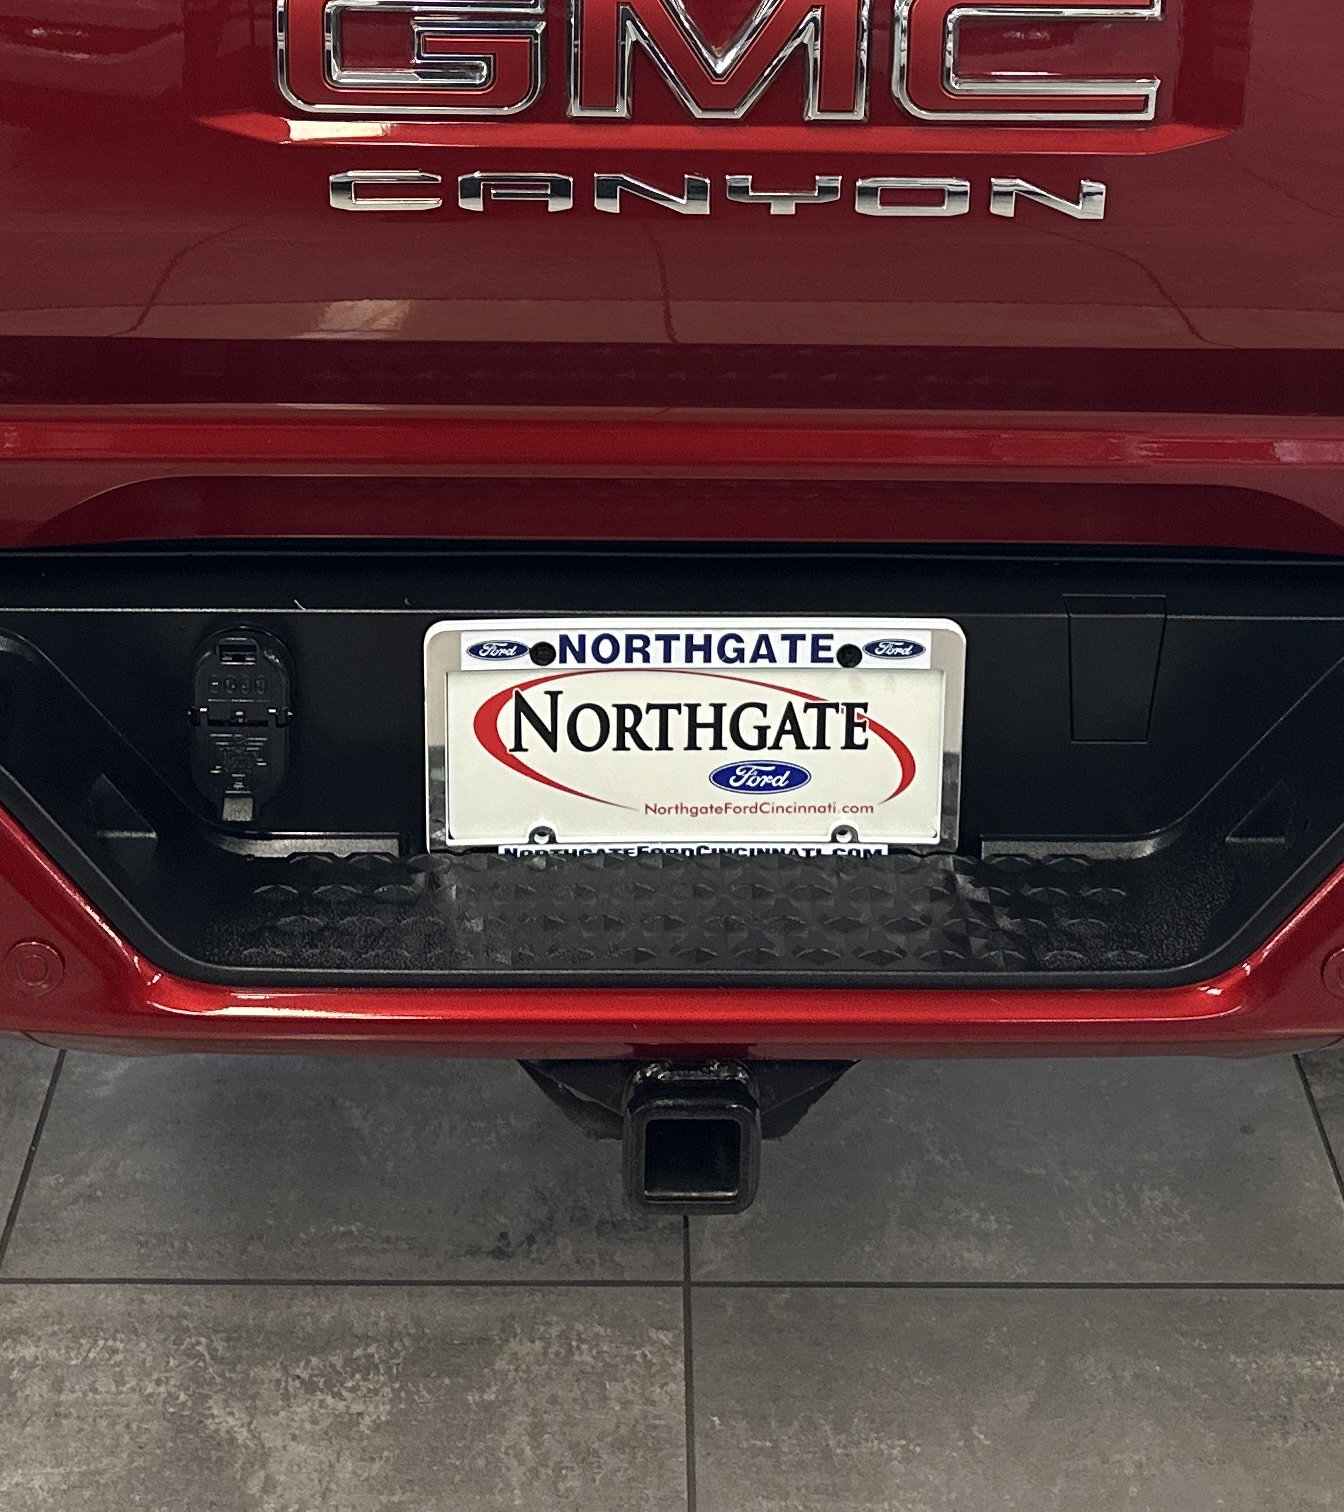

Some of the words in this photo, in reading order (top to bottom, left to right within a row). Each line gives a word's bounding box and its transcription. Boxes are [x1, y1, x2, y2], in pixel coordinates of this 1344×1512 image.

[328, 169, 1108, 221] CANYON
[558, 632, 834, 664] NORTHGATE
[508, 689, 870, 753] NORTHGATE
[728, 764, 792, 788] Ford
[644, 801, 874, 818] NorthgateFordCincinnati.com
